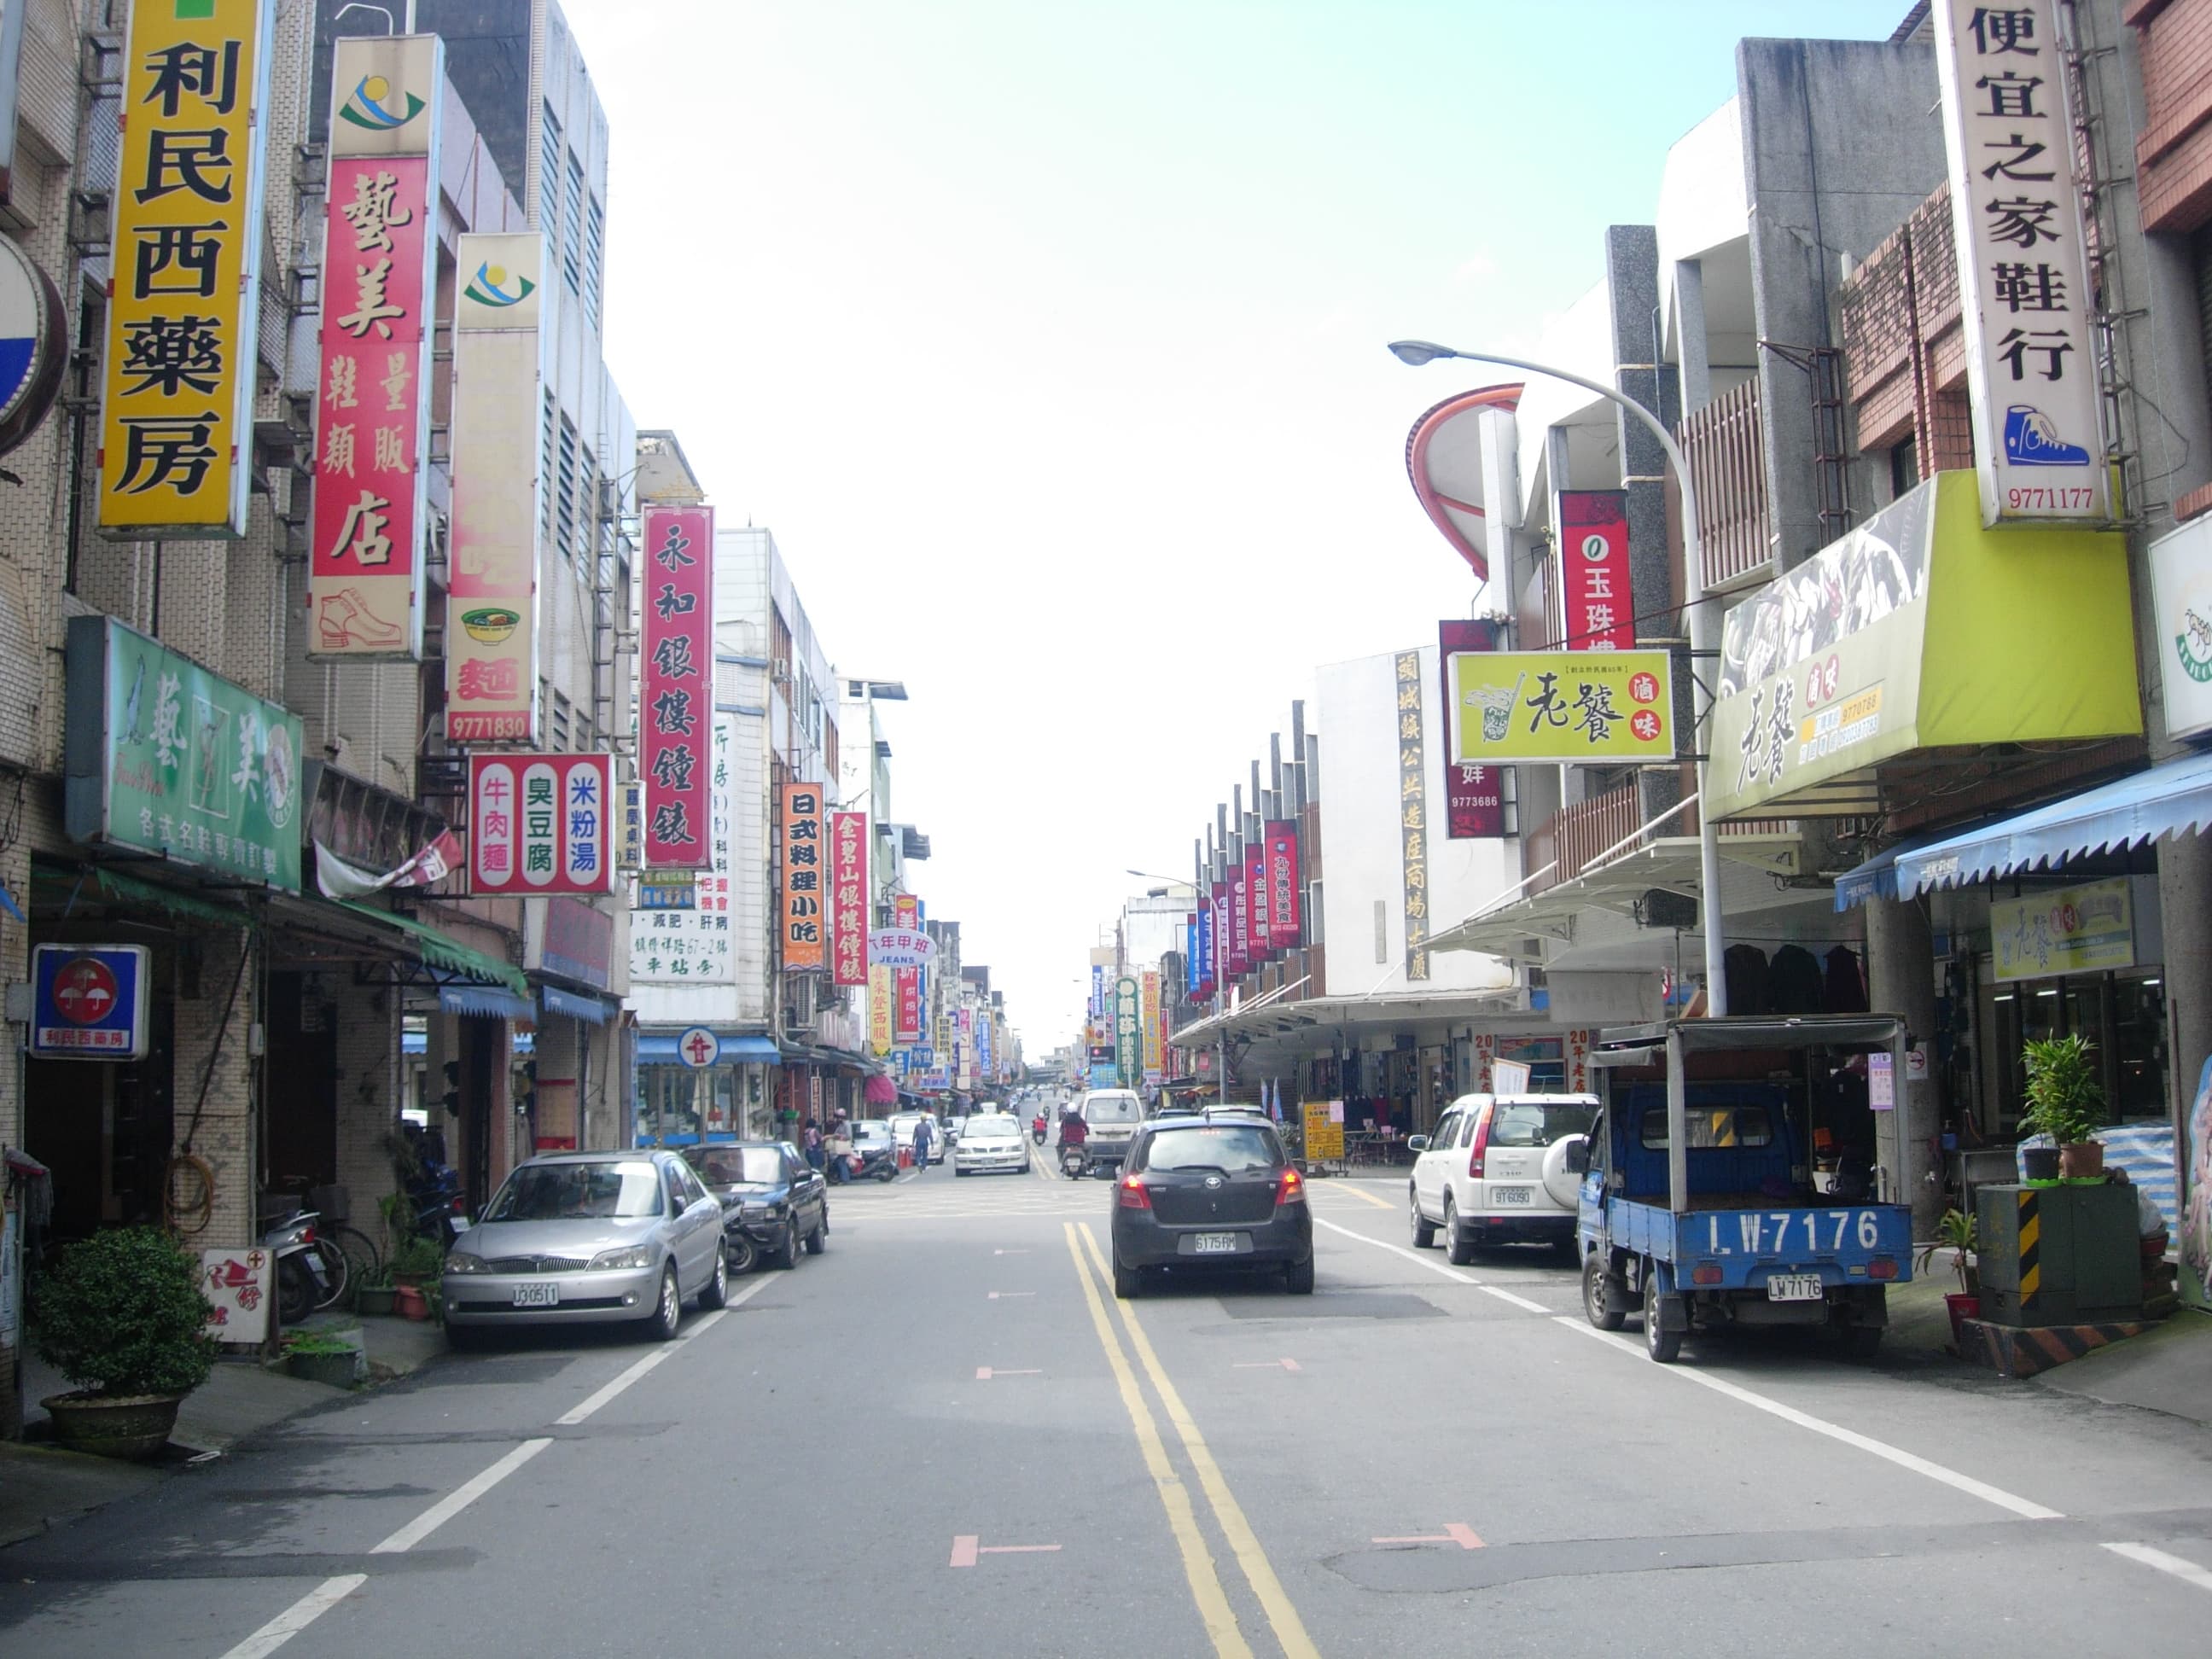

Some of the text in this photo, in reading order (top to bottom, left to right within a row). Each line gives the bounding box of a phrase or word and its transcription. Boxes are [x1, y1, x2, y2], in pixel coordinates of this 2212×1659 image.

[1967, 8, 2074, 381] 便宜之家鞋行
[114, 40, 242, 495] 利民西藥房
[336, 172, 413, 339] 藝美
[331, 490, 391, 566] 店
[2009, 487, 2093, 510] 9771177
[458, 658, 520, 701] 麵
[650, 526, 698, 846] 永和銀樓鐘錶
[453, 718, 527, 738] 9771830
[482, 777, 509, 873] 牛肉麵
[527, 777, 555, 873] 臭豆腐
[570, 777, 597, 873] 米粉湯
[789, 793, 818, 944] 日式料理小吃
[879, 956, 915, 964] JEANS
